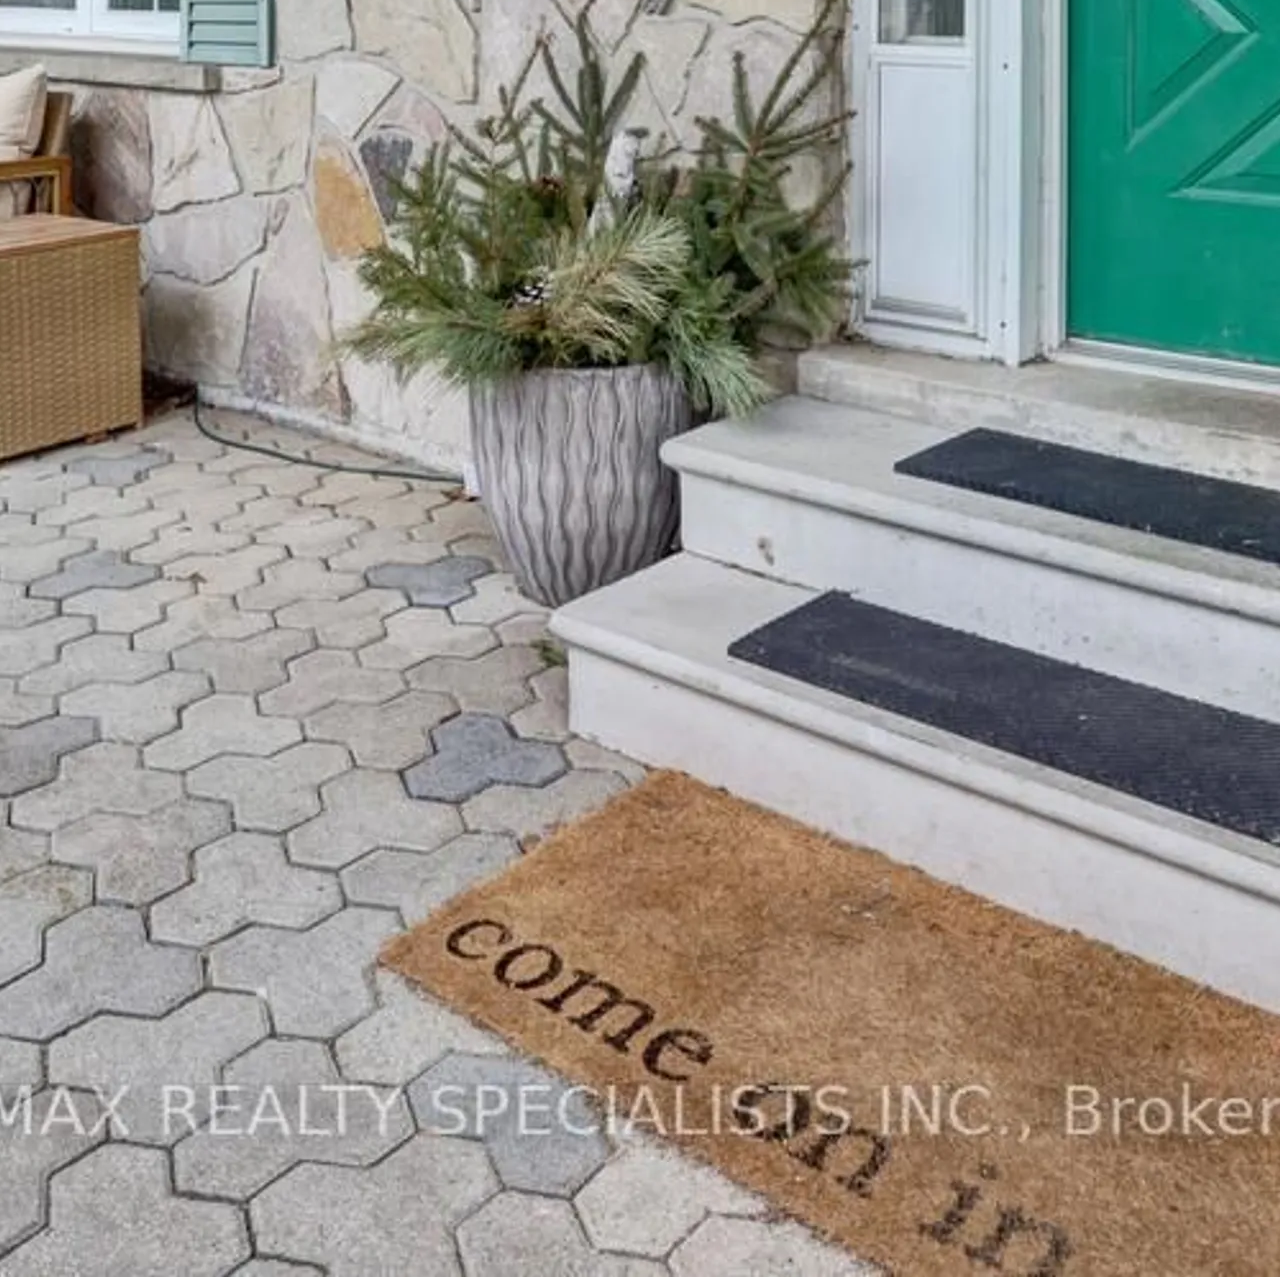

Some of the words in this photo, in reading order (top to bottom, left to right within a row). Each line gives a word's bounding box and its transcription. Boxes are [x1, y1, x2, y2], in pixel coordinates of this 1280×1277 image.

[445, 918, 714, 1081] come
[732, 1081, 891, 1198] on
[919, 1160, 1075, 1277] in
